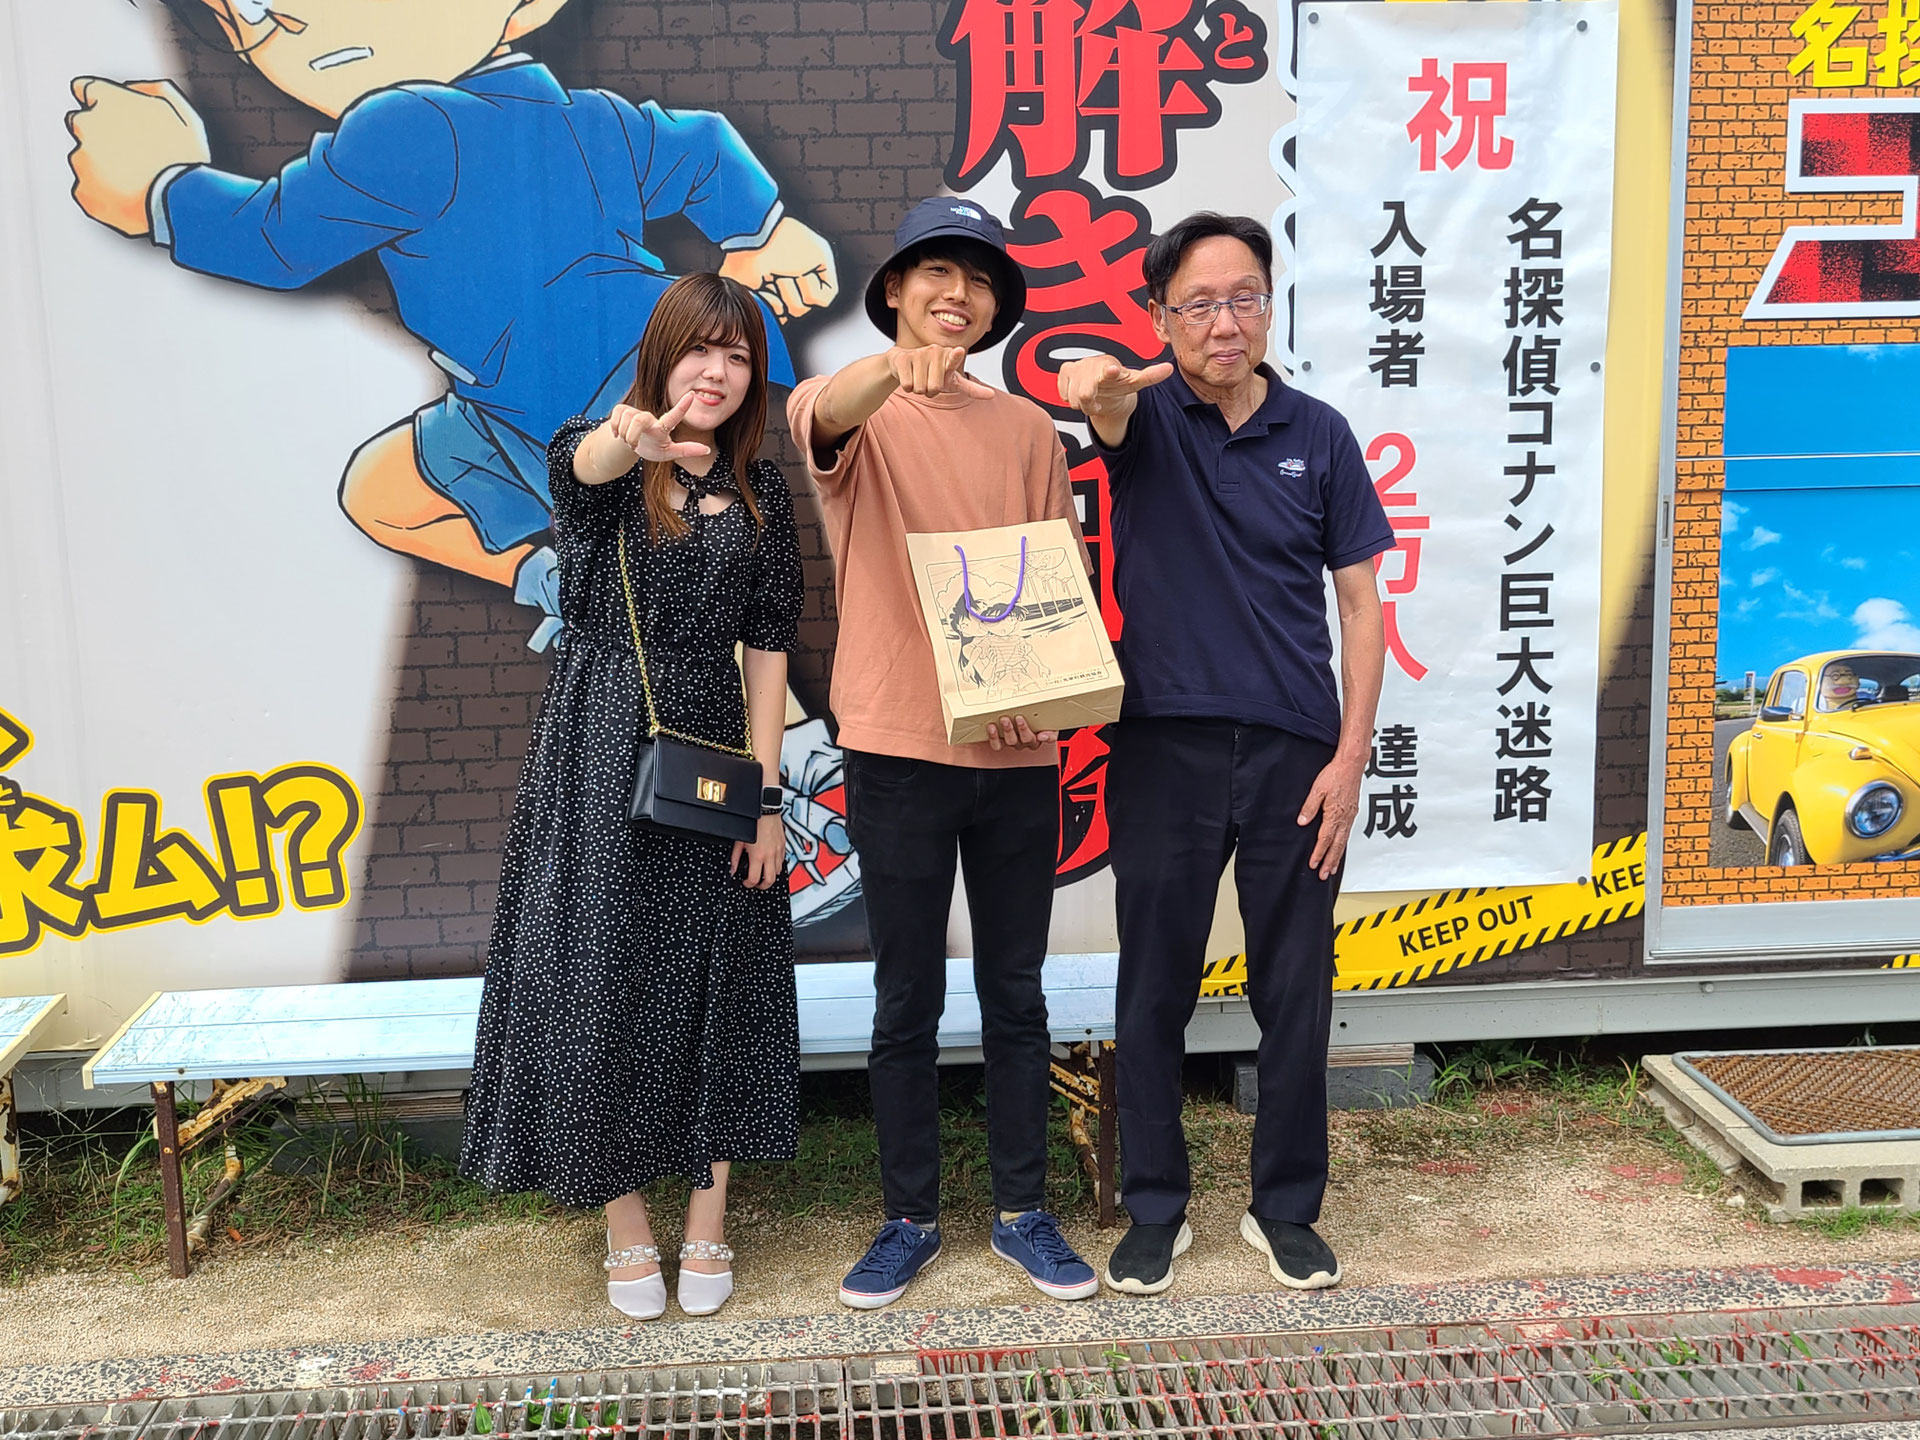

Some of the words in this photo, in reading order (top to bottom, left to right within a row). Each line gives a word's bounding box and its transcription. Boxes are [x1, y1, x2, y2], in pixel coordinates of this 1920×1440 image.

[1213, 12, 1256, 69] と
[1406, 57, 1515, 172] 祝
[1368, 199, 1428, 389] 入場者
[1493, 197, 1565, 823] 名探偵コナン巨大迷路
[1362, 723, 1420, 840] 達成
[1397, 916, 1470, 957] KEEP
[1477, 896, 1534, 930] OUT
